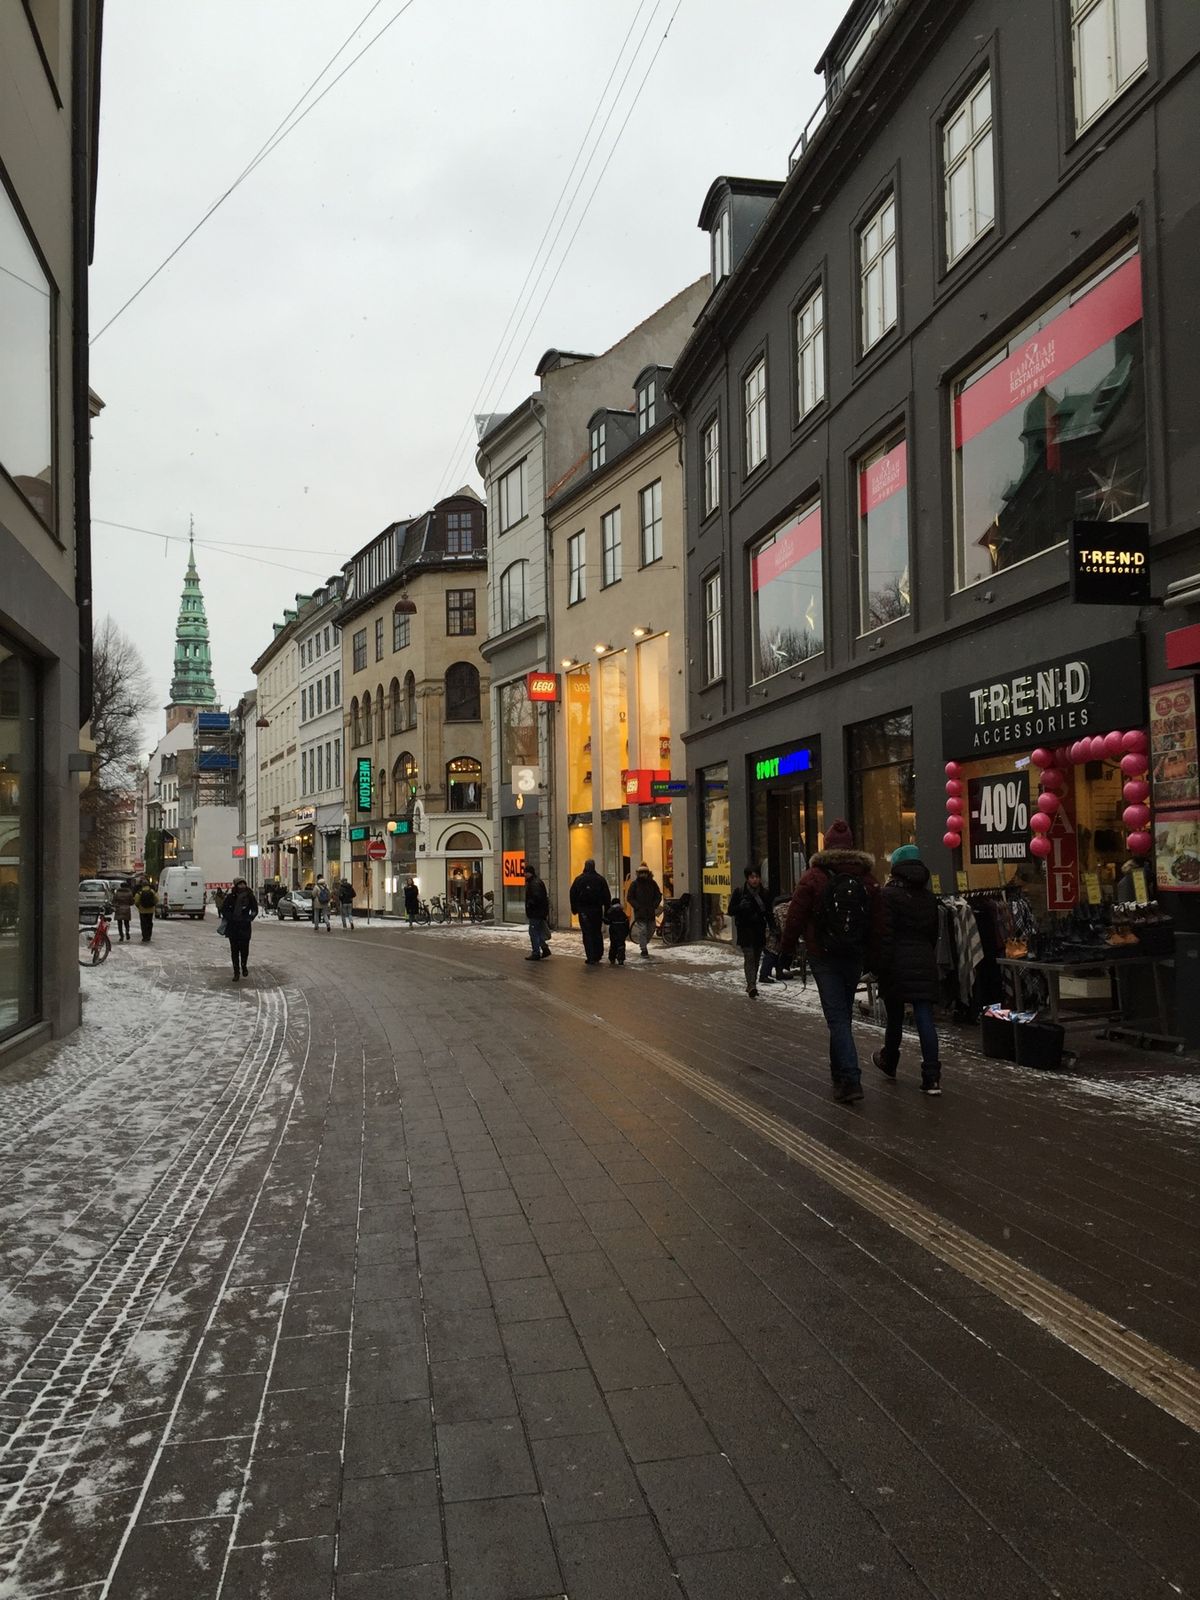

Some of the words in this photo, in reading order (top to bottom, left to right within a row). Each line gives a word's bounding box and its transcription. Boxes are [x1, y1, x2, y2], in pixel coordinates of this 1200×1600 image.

[1009, 350, 1056, 393] RESTAURANT
[1079, 565, 1147, 574] ACCESSORIES
[532, 681, 554, 692] LEGO
[973, 709, 1089, 747] ACCESSORIES
[359, 760, 371, 809] WEEKDAY
[518, 768, 536, 791] 3
[971, 779, 1029, 833] -40%
[975, 844, 979, 859] I
[979, 843, 993, 859] HELE
[993, 842, 1027, 858] BUTIKKEN
[504, 858, 525, 878] SALE
